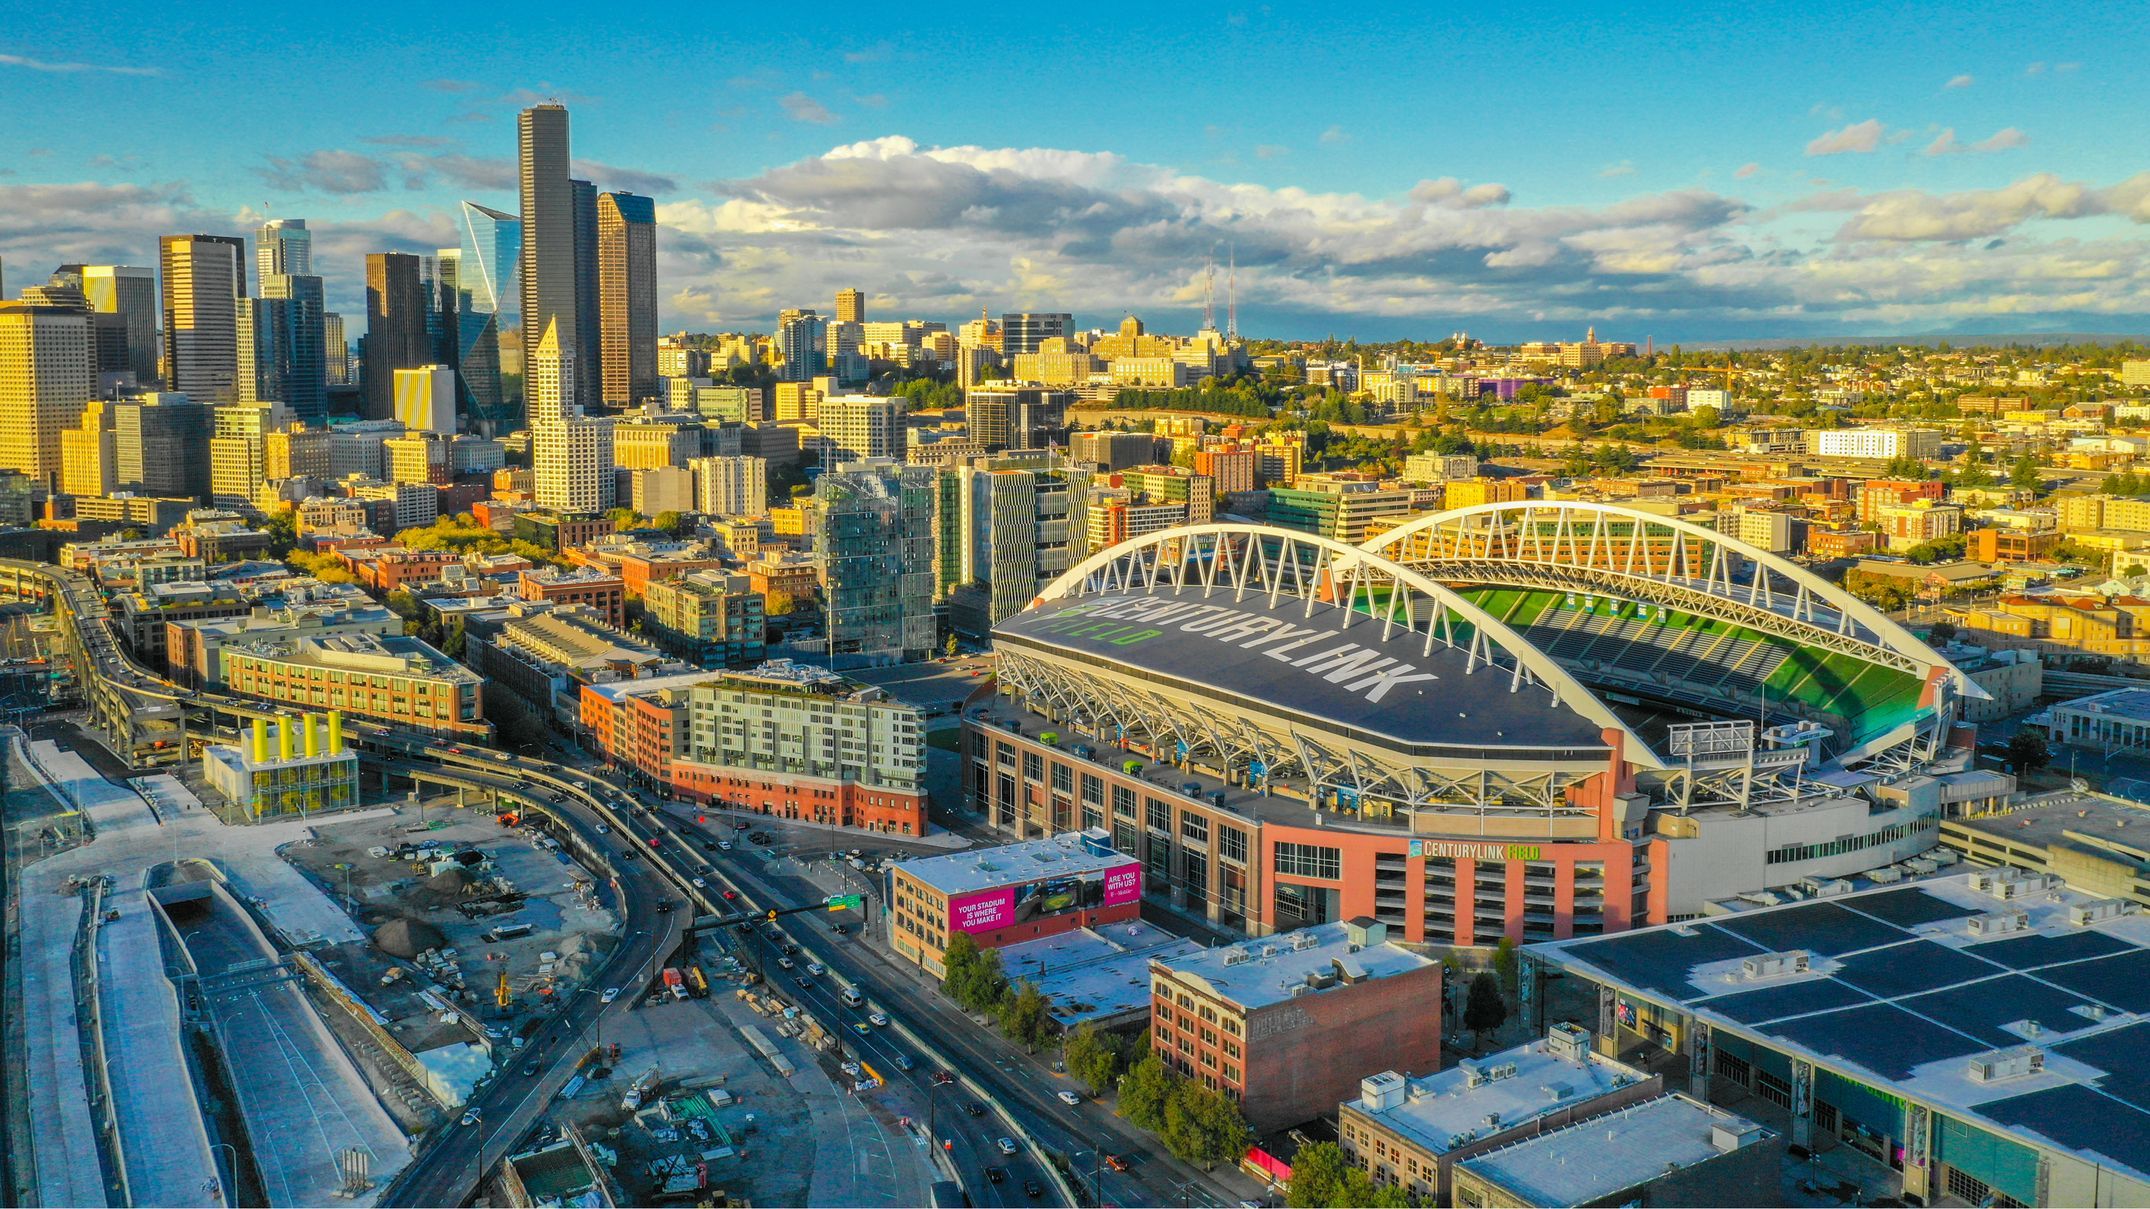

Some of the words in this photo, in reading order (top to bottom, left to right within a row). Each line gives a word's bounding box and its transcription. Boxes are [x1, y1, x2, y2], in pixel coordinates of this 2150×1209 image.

[1030, 619, 1163, 645] FIELD
[1085, 596, 1439, 703] CENTURYLINK
[1424, 841, 1505, 860] CENTURYLINK
[1507, 844, 1540, 861] FIELD
[1107, 881, 1124, 891] WITH
[1124, 878, 1136, 888] US?
[1108, 874, 1121, 884] ARE
[1122, 872, 1135, 881] YOU
[959, 904, 977, 914] YOUR
[977, 898, 1006, 910] STADIUM
[966, 911, 974, 919] IS
[974, 907, 997, 918] WHERE
[962, 919, 976, 928] YOU
[976, 914, 995, 925] MAKE
[995, 913, 1002, 921] IT
